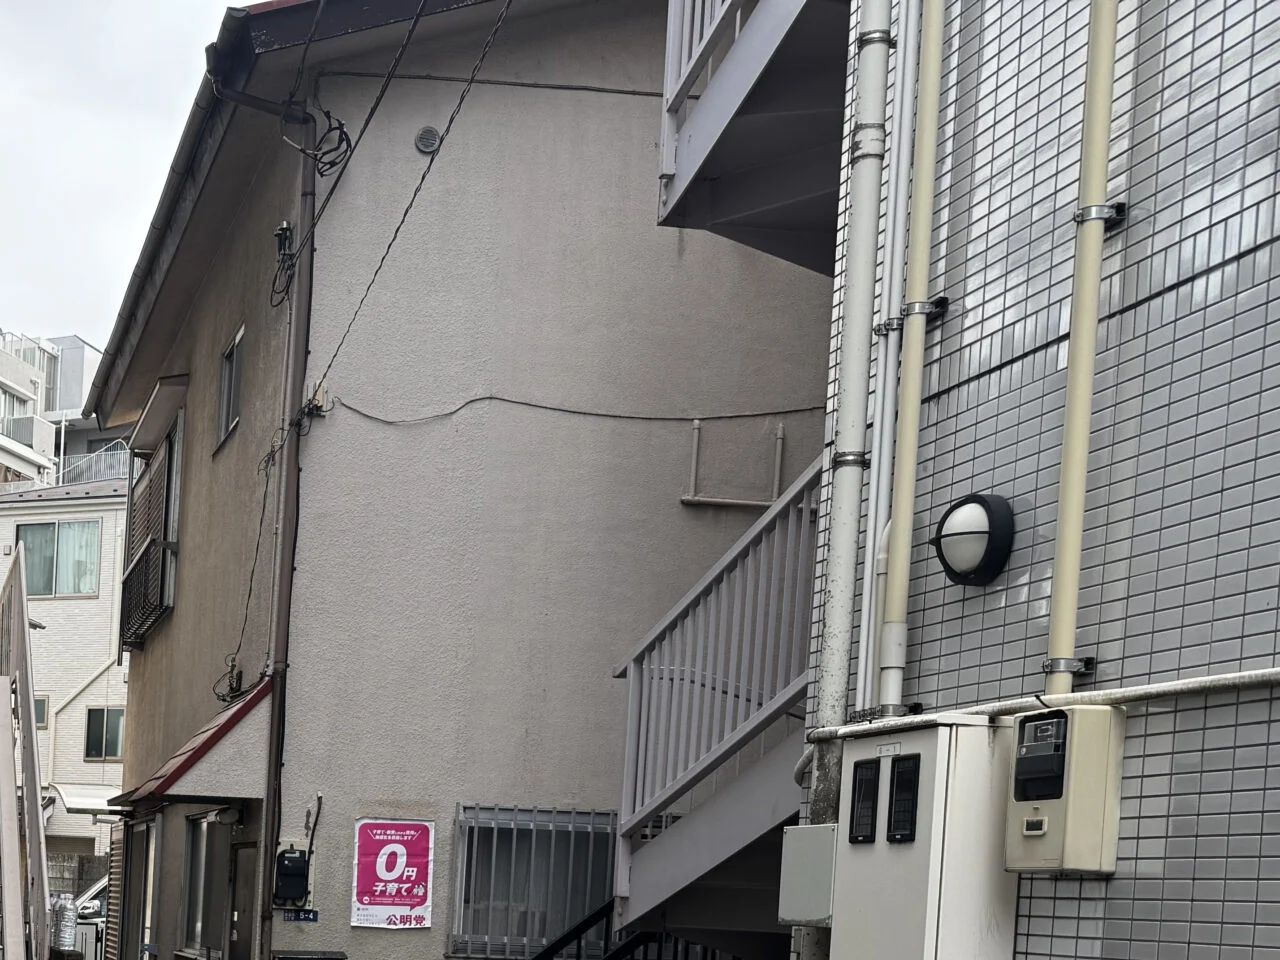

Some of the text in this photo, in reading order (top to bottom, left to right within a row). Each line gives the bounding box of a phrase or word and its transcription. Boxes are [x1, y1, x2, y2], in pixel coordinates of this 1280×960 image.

[372, 882, 412, 896] 子育て
[385, 914, 426, 927] 公明党
